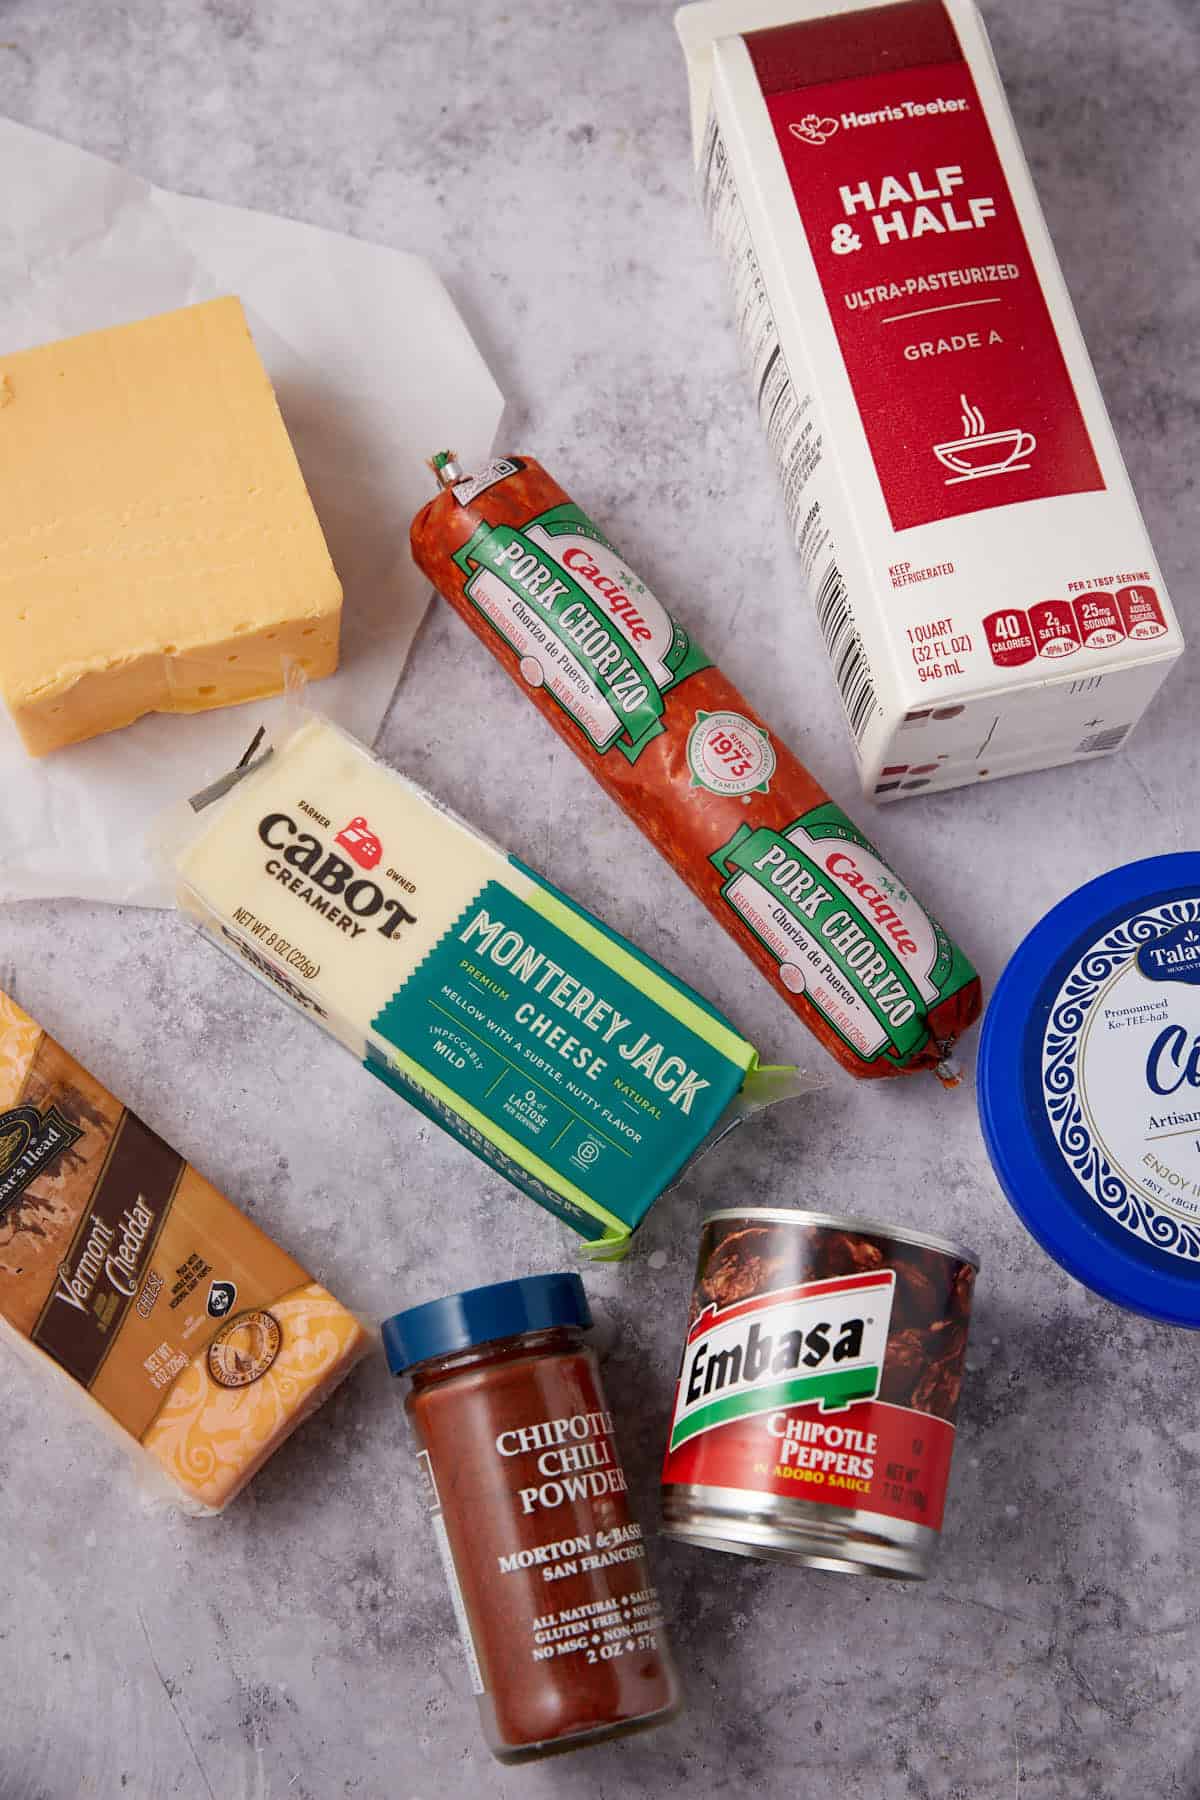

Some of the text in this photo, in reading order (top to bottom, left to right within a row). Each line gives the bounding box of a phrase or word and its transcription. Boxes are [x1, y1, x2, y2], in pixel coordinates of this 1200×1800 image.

[838, 165, 964, 216] HALF
[830, 198, 996, 255] & HALF
[844, 263, 1020, 310] ULTRA-PASTEURIZED
[903, 330, 1003, 360] GRADE A
[888, 562, 911, 577] KEEP
[892, 563, 954, 588] REFRIGERATED
[1067, 572, 1150, 592] PER 2 TBSP SERVING
[562, 548, 652, 641] Cacique
[1082, 602, 1110, 619] 25mg
[494, 541, 570, 609] PORK
[558, 603, 649, 713] CHORIZO
[907, 619, 953, 644] 1 QUART
[995, 615, 1019, 638] 40
[1039, 625, 1071, 639] SAT FAT
[1045, 612, 1060, 627] 2g
[1083, 616, 1117, 631] SODIUM
[511, 600, 546, 642] Chorizo
[545, 639, 558, 658] de
[556, 654, 590, 695] Puerco
[912, 635, 972, 662] (32 FL OZ)
[991, 637, 1031, 653] CALORIES
[917, 662, 965, 682] 946 mL
[709, 731, 752, 777] 1973
[729, 733, 753, 758] SINCE
[297, 800, 331, 829] FARMER
[385, 868, 417, 894] OWNED
[265, 860, 367, 939] CREAMERY
[825, 852, 918, 956] Cacique
[233, 907, 321, 980] NET WT. 8 OZ (226g)
[752, 844, 833, 920] PORK
[821, 910, 916, 1028] CHORIZO
[771, 907, 808, 951] Chorizo
[806, 949, 821, 967] de
[819, 962, 856, 1006] Puerco
[458, 909, 632, 1044] MONTEREY
[619, 1033, 711, 1115] JACK
[1104, 998, 1168, 1019] Pronounced
[428, 1025, 486, 1070] IMPECCABLY
[433, 1040, 466, 1069] MILD
[459, 960, 663, 1120] PREMIUM CHEESE NATURAL
[441, 985, 486, 1021] MELLOW
[486, 1019, 514, 1044] WITH
[514, 1042, 523, 1051] A
[523, 1049, 563, 1085] SUBTLE,
[566, 1081, 600, 1111] NUTTY
[601, 1109, 642, 1143] FLAVOR
[508, 1094, 549, 1128] LACTOSE
[1142, 1152, 1190, 1190] ENJOY
[105, 1191, 155, 1297] Cheddar
[55, 1214, 114, 1314] Vermont
[686, 1318, 864, 1407] Embasa
[538, 1441, 612, 1477] CHILI
[518, 1468, 628, 1515] POWDER
[774, 1465, 825, 1485] ADOBO
[827, 1473, 872, 1493] SAUCE
[498, 1534, 591, 1573] MORTON
[596, 1531, 612, 1548] &
[542, 1560, 579, 1582] SAN
[532, 1615, 559, 1631] ALL
[559, 1598, 620, 1623] NATURAL
[534, 1620, 590, 1645] GLUTEN
[591, 1610, 623, 1629] FREE
[532, 1646, 554, 1662] NO
[557, 1636, 589, 1655] MSG
[587, 1649, 599, 1664] 2
[600, 1642, 624, 1660] OZ
